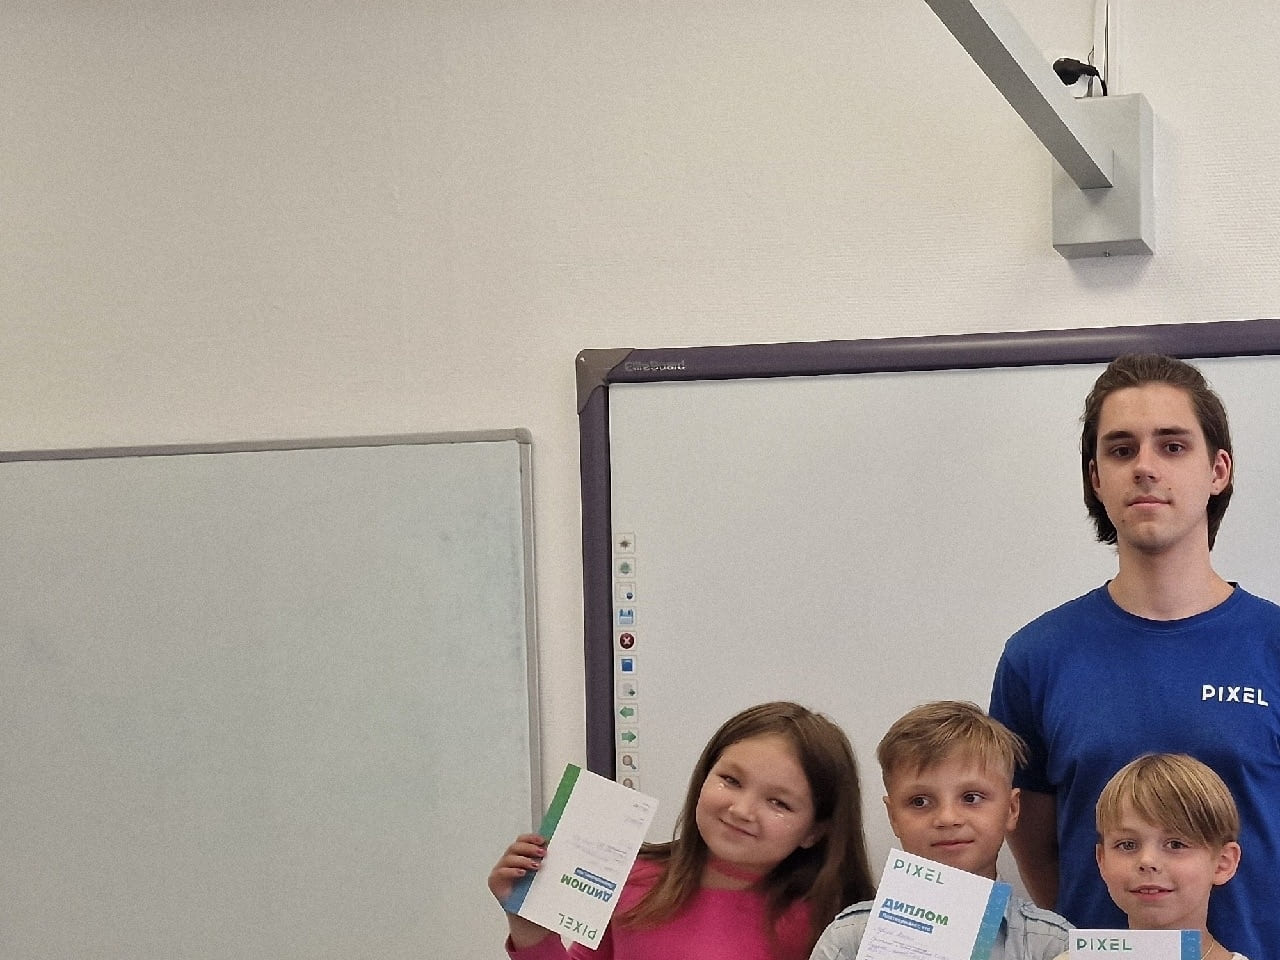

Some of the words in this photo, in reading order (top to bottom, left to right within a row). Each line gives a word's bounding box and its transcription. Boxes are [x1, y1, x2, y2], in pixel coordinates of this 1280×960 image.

[1201, 684, 1269, 707] PIXEL
[893, 858, 945, 885] PIXEL
[559, 873, 613, 903] ДИПЛОМ
[881, 897, 949, 926] ДИПЛОМ
[558, 912, 598, 941] PIXEL
[1076, 938, 1132, 951] PIXEL
